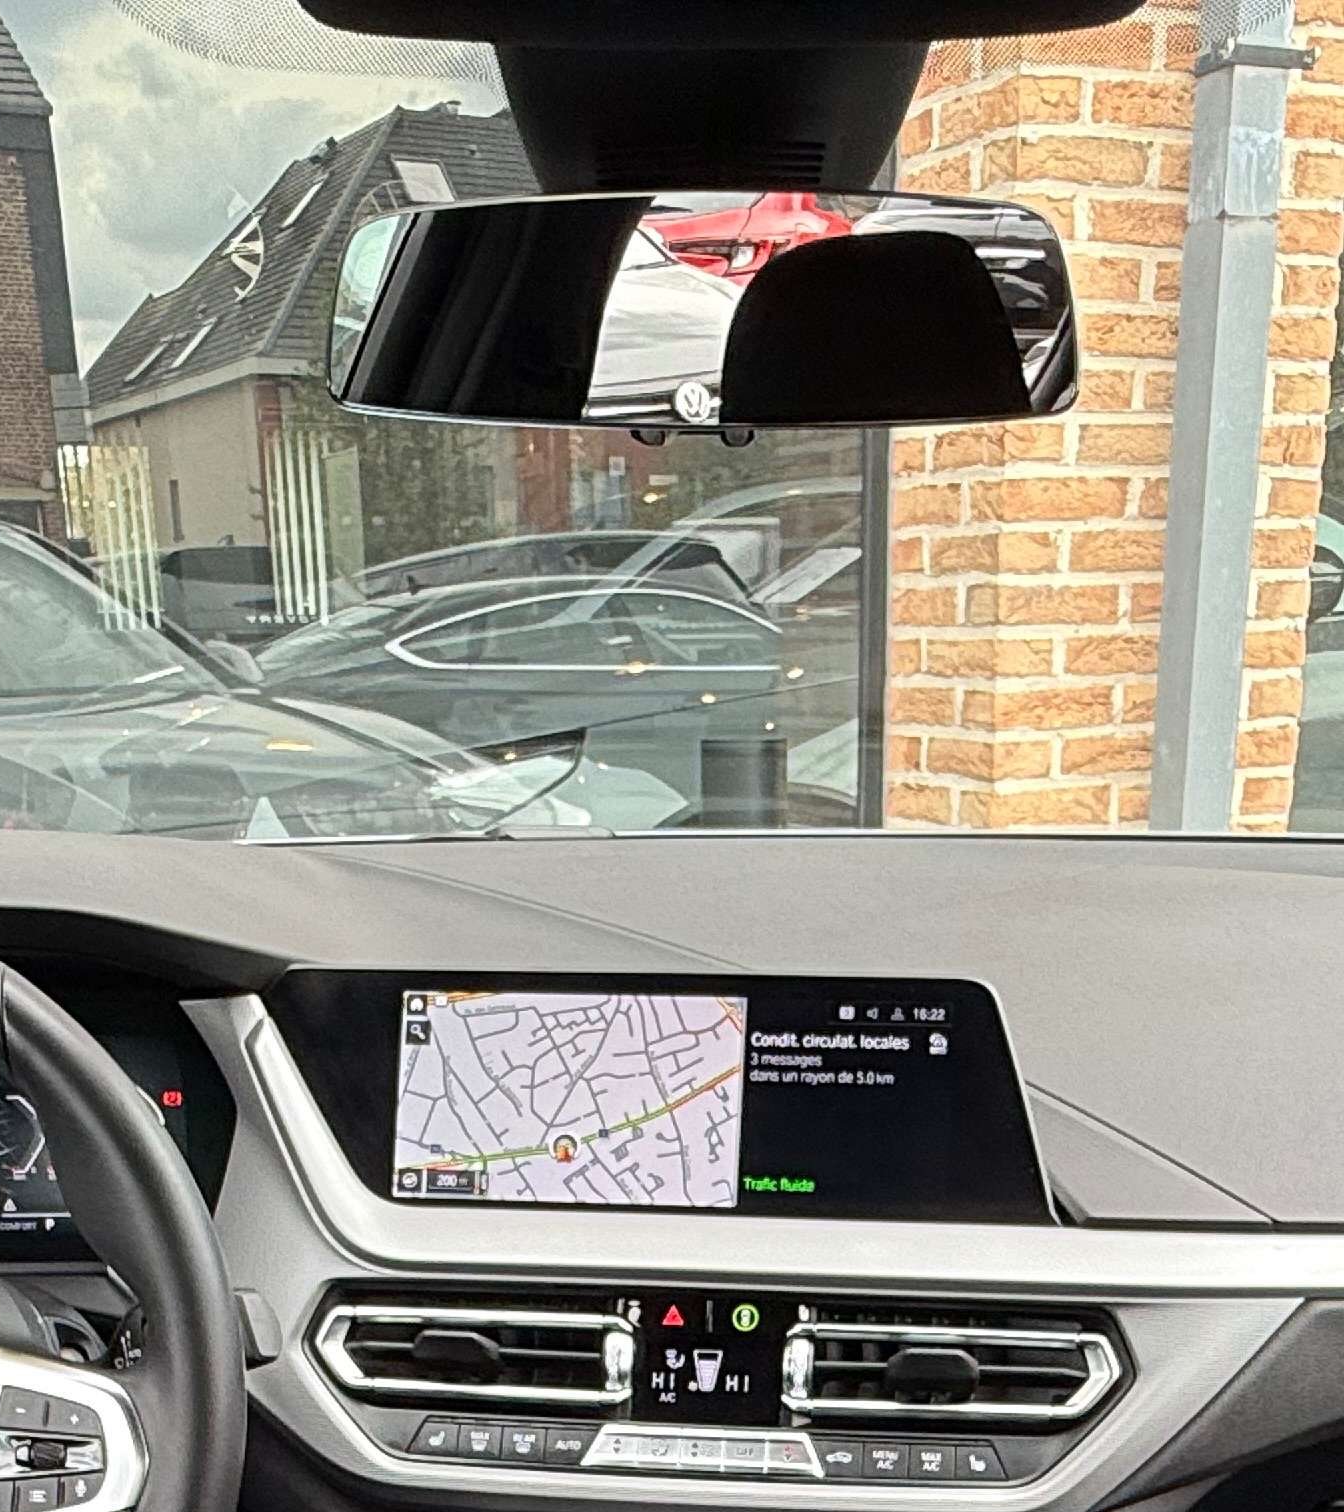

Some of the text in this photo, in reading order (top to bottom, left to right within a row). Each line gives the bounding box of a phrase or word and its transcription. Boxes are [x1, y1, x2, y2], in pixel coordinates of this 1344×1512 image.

[750, 1031, 911, 1050] Condit. circulat. locales
[750, 1053, 823, 1068] 3 messages
[749, 1069, 779, 1082] dans
[782, 1073, 798, 1082] un
[800, 1072, 836, 1086] rayon
[837, 1071, 855, 1084] de
[876, 1072, 895, 1085] km
